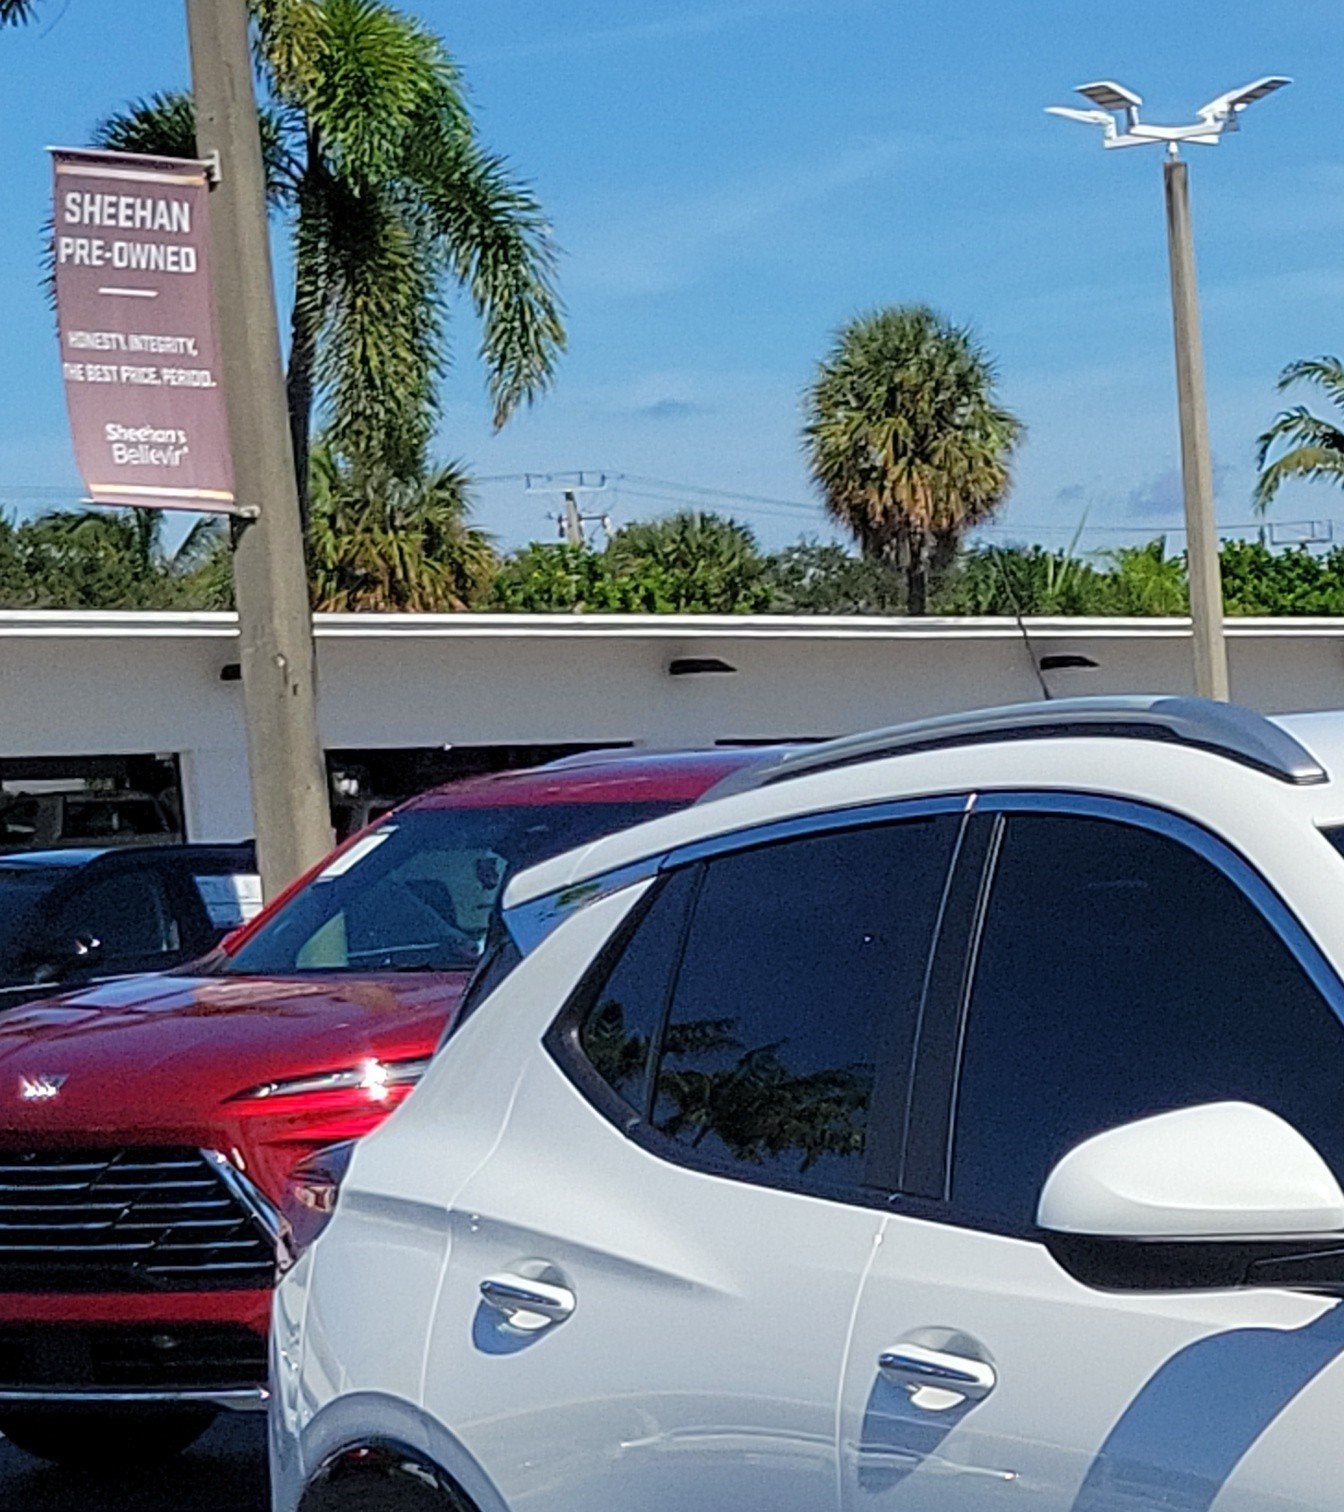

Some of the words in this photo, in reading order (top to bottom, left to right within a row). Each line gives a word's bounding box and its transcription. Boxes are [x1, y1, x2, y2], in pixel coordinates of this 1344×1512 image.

[64, 192, 190, 233] SHEEHAN
[60, 237, 197, 273] PRE-OWNED
[85, 363, 118, 382] BEST
